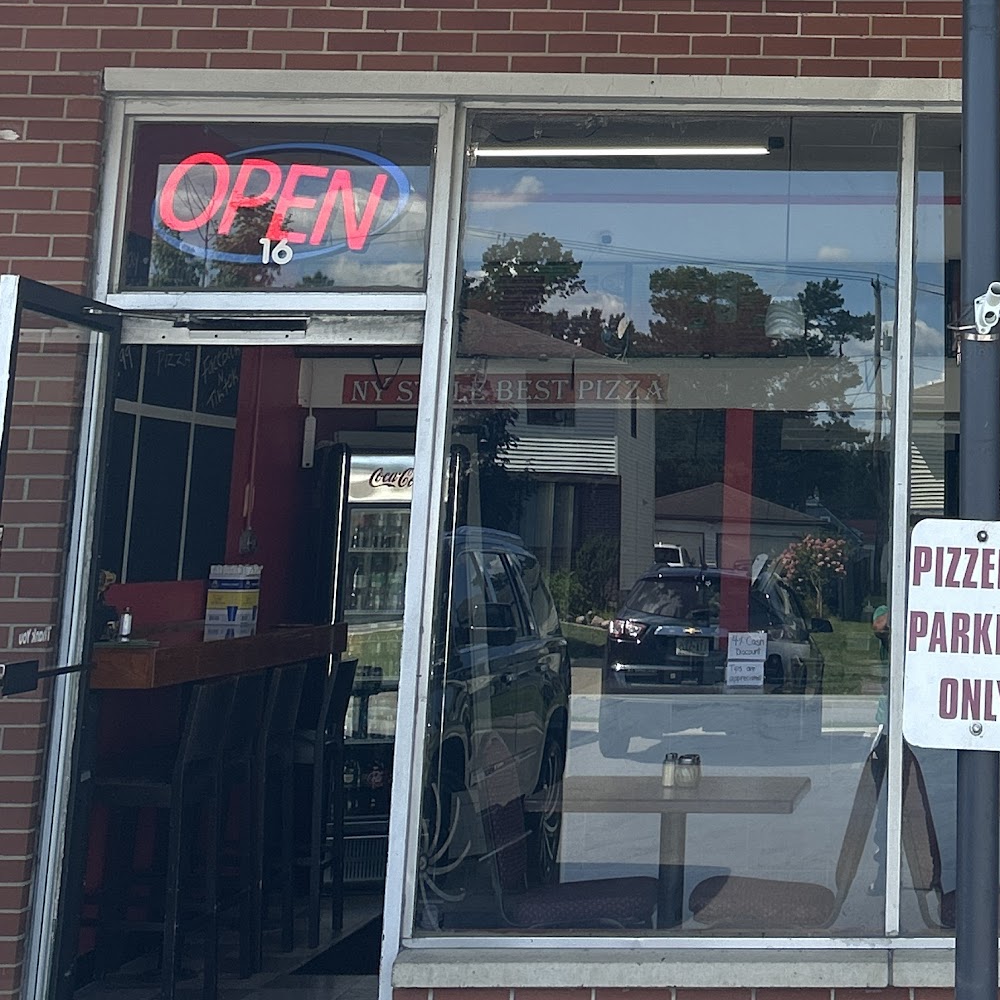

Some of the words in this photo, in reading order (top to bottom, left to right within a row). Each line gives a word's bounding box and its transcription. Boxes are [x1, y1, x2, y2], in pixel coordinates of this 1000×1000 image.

[158, 152, 389, 251] OPEN
[259, 238, 293, 265] 16
[351, 377, 392, 401] NY
[496, 380, 569, 401] BEST
[576, 380, 665, 401] PIZZA
